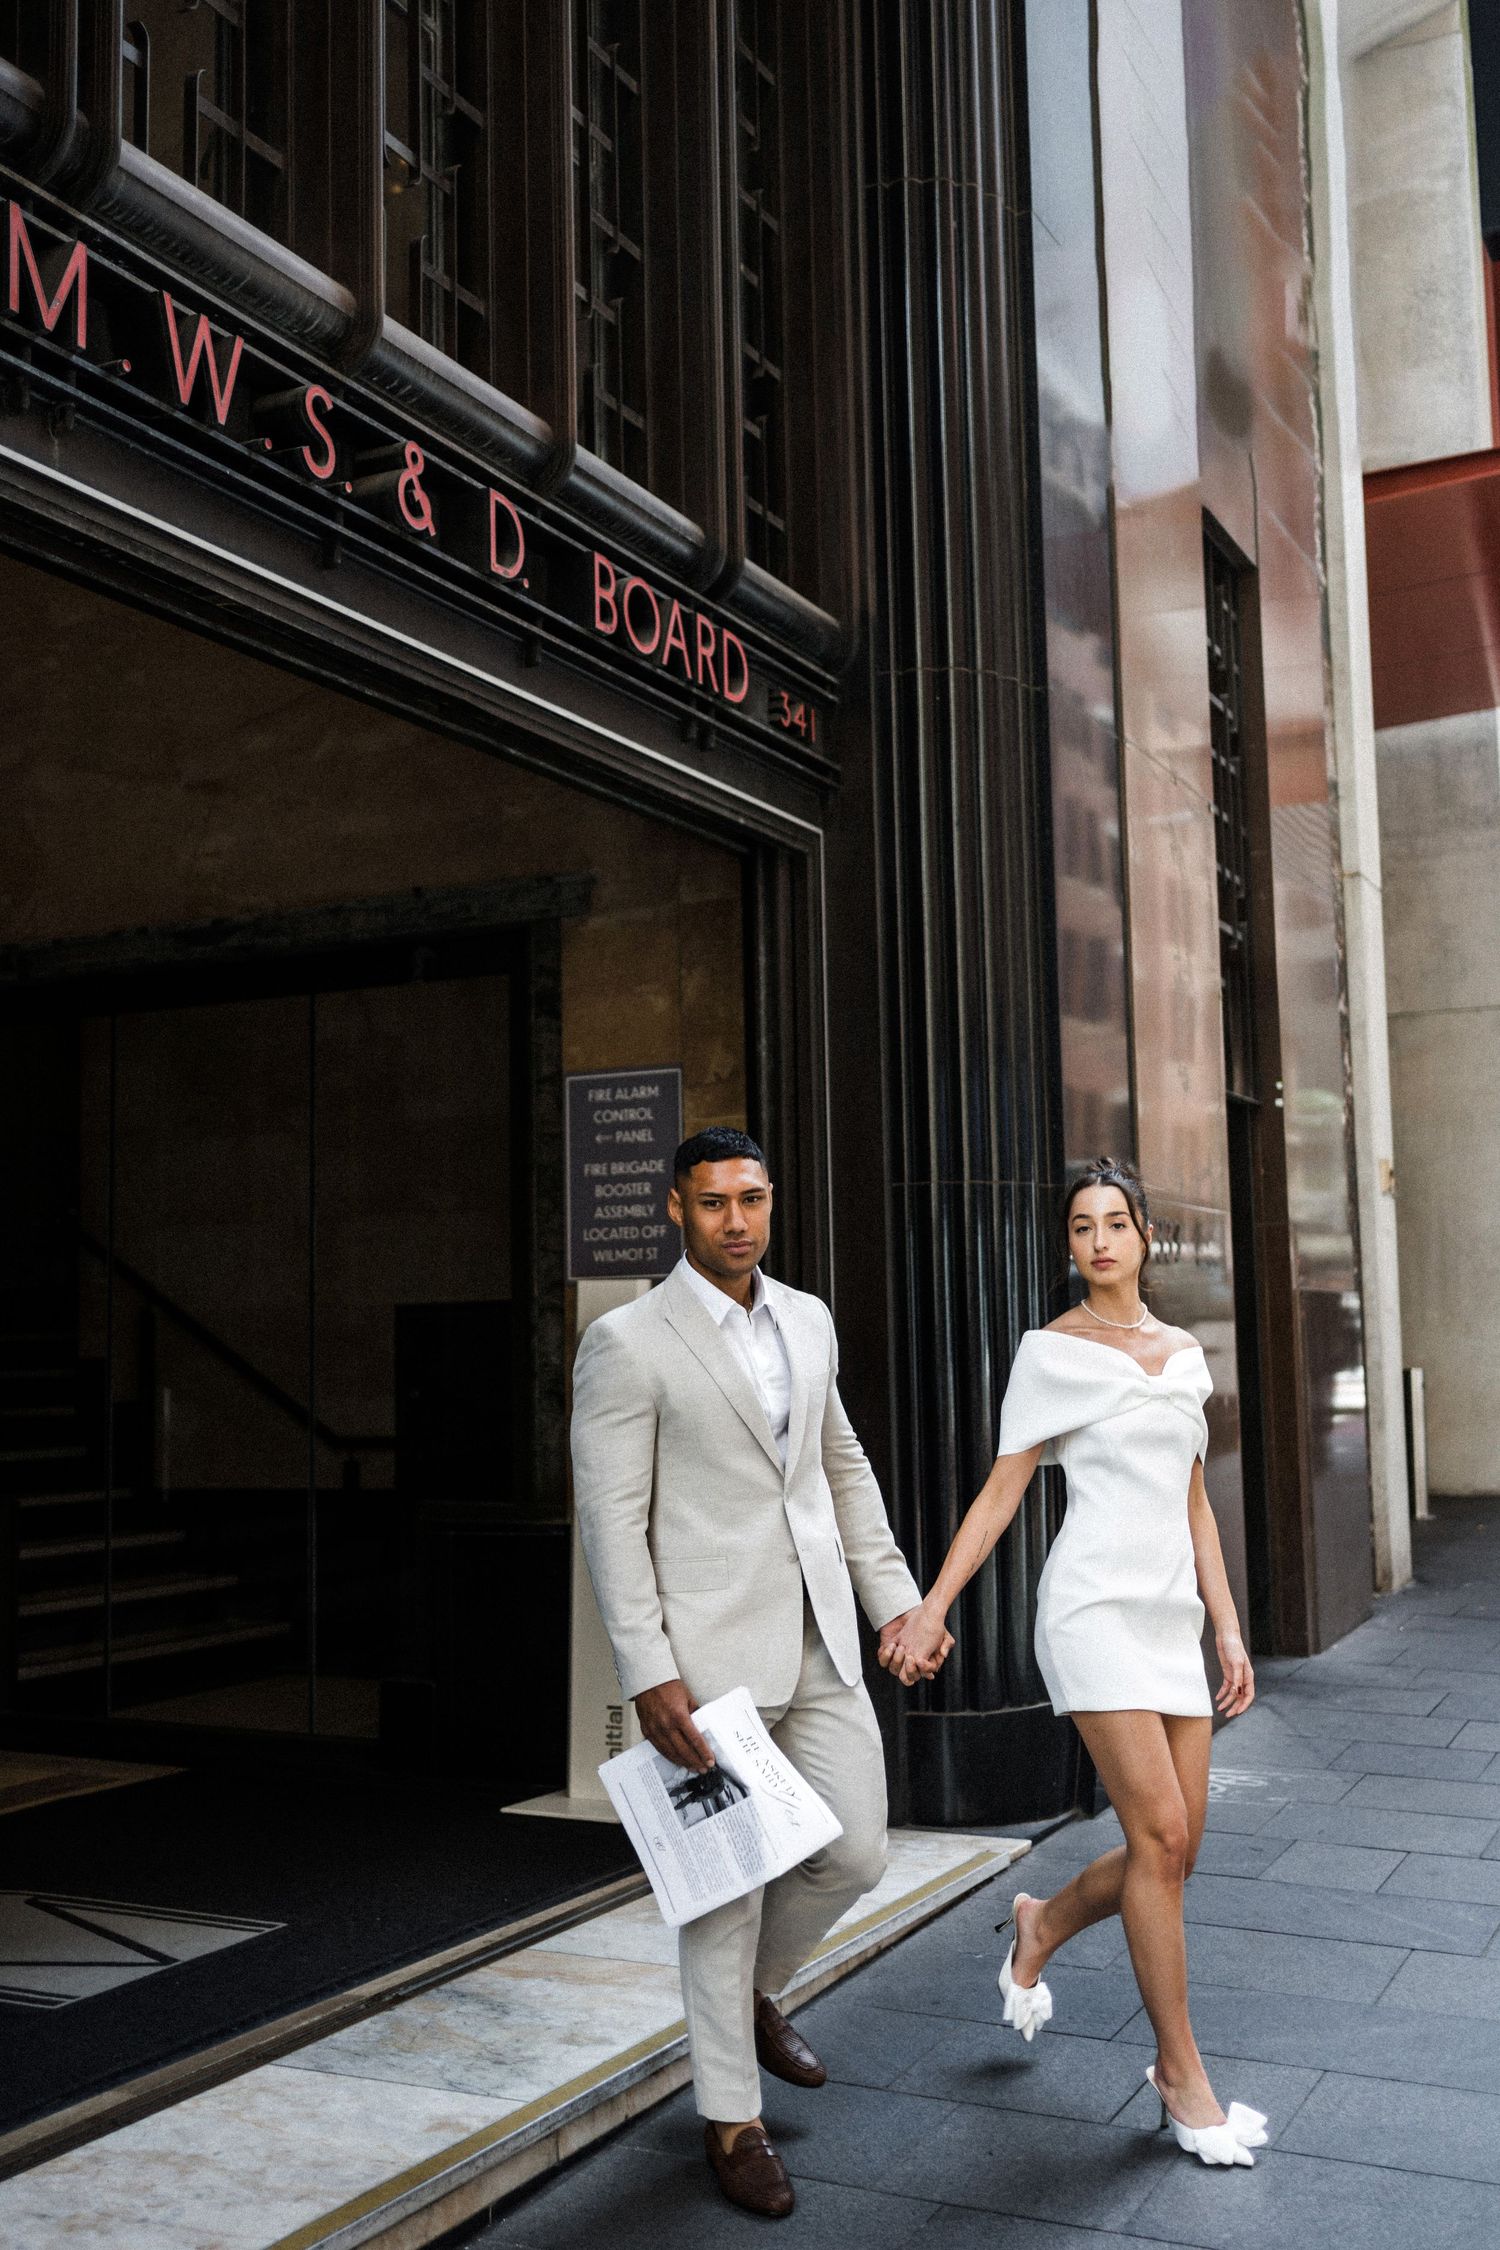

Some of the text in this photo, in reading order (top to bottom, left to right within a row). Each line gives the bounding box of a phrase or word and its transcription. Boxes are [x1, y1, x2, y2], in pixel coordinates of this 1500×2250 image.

[398, 440, 437, 537] &
[594, 551, 749, 703] BOARD
[779, 691, 816, 743] 341
[588, 1085, 660, 1102] FIRE ALARM
[593, 1107, 654, 1123] CONTROL
[615, 1128, 655, 1143] PANEL
[584, 1159, 666, 1176] FIRE BRIGADE
[594, 1182, 652, 1198] BOOSTER
[594, 1203, 656, 1219] ASSEMBLY
[583, 1224, 668, 1241] LOCATED OFF
[593, 1246, 658, 1263] WILMOT ST
